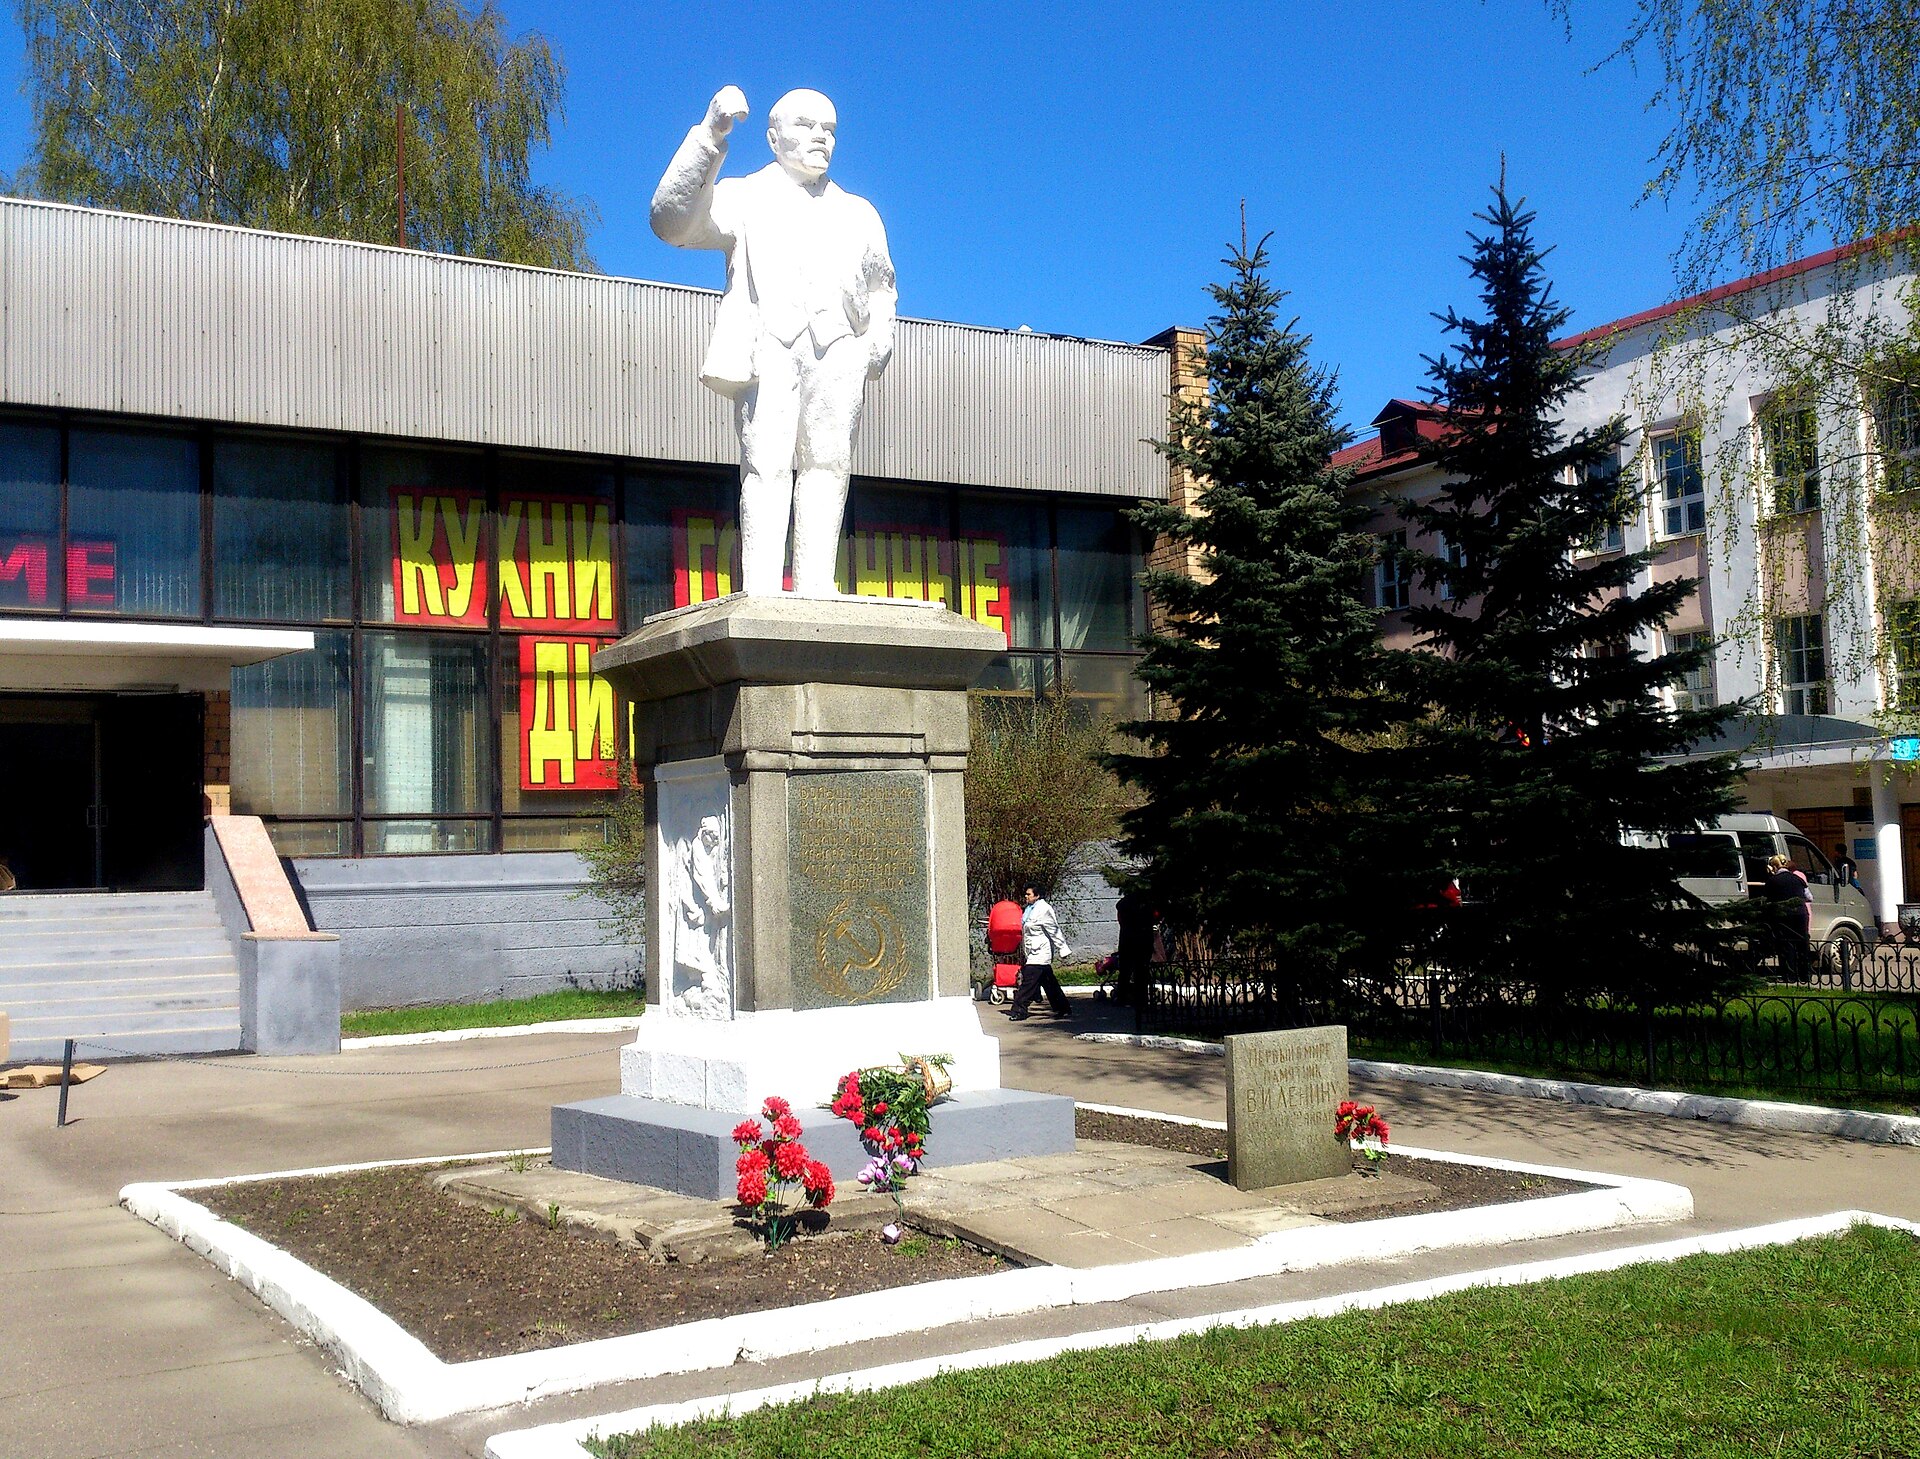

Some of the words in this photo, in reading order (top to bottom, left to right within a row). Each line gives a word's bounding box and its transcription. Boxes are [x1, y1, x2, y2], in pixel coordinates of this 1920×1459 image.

[398, 495, 612, 619] КУХНИ
[686, 516, 1003, 632] ГННЫЕ
[529, 641, 635, 784] ДИ
